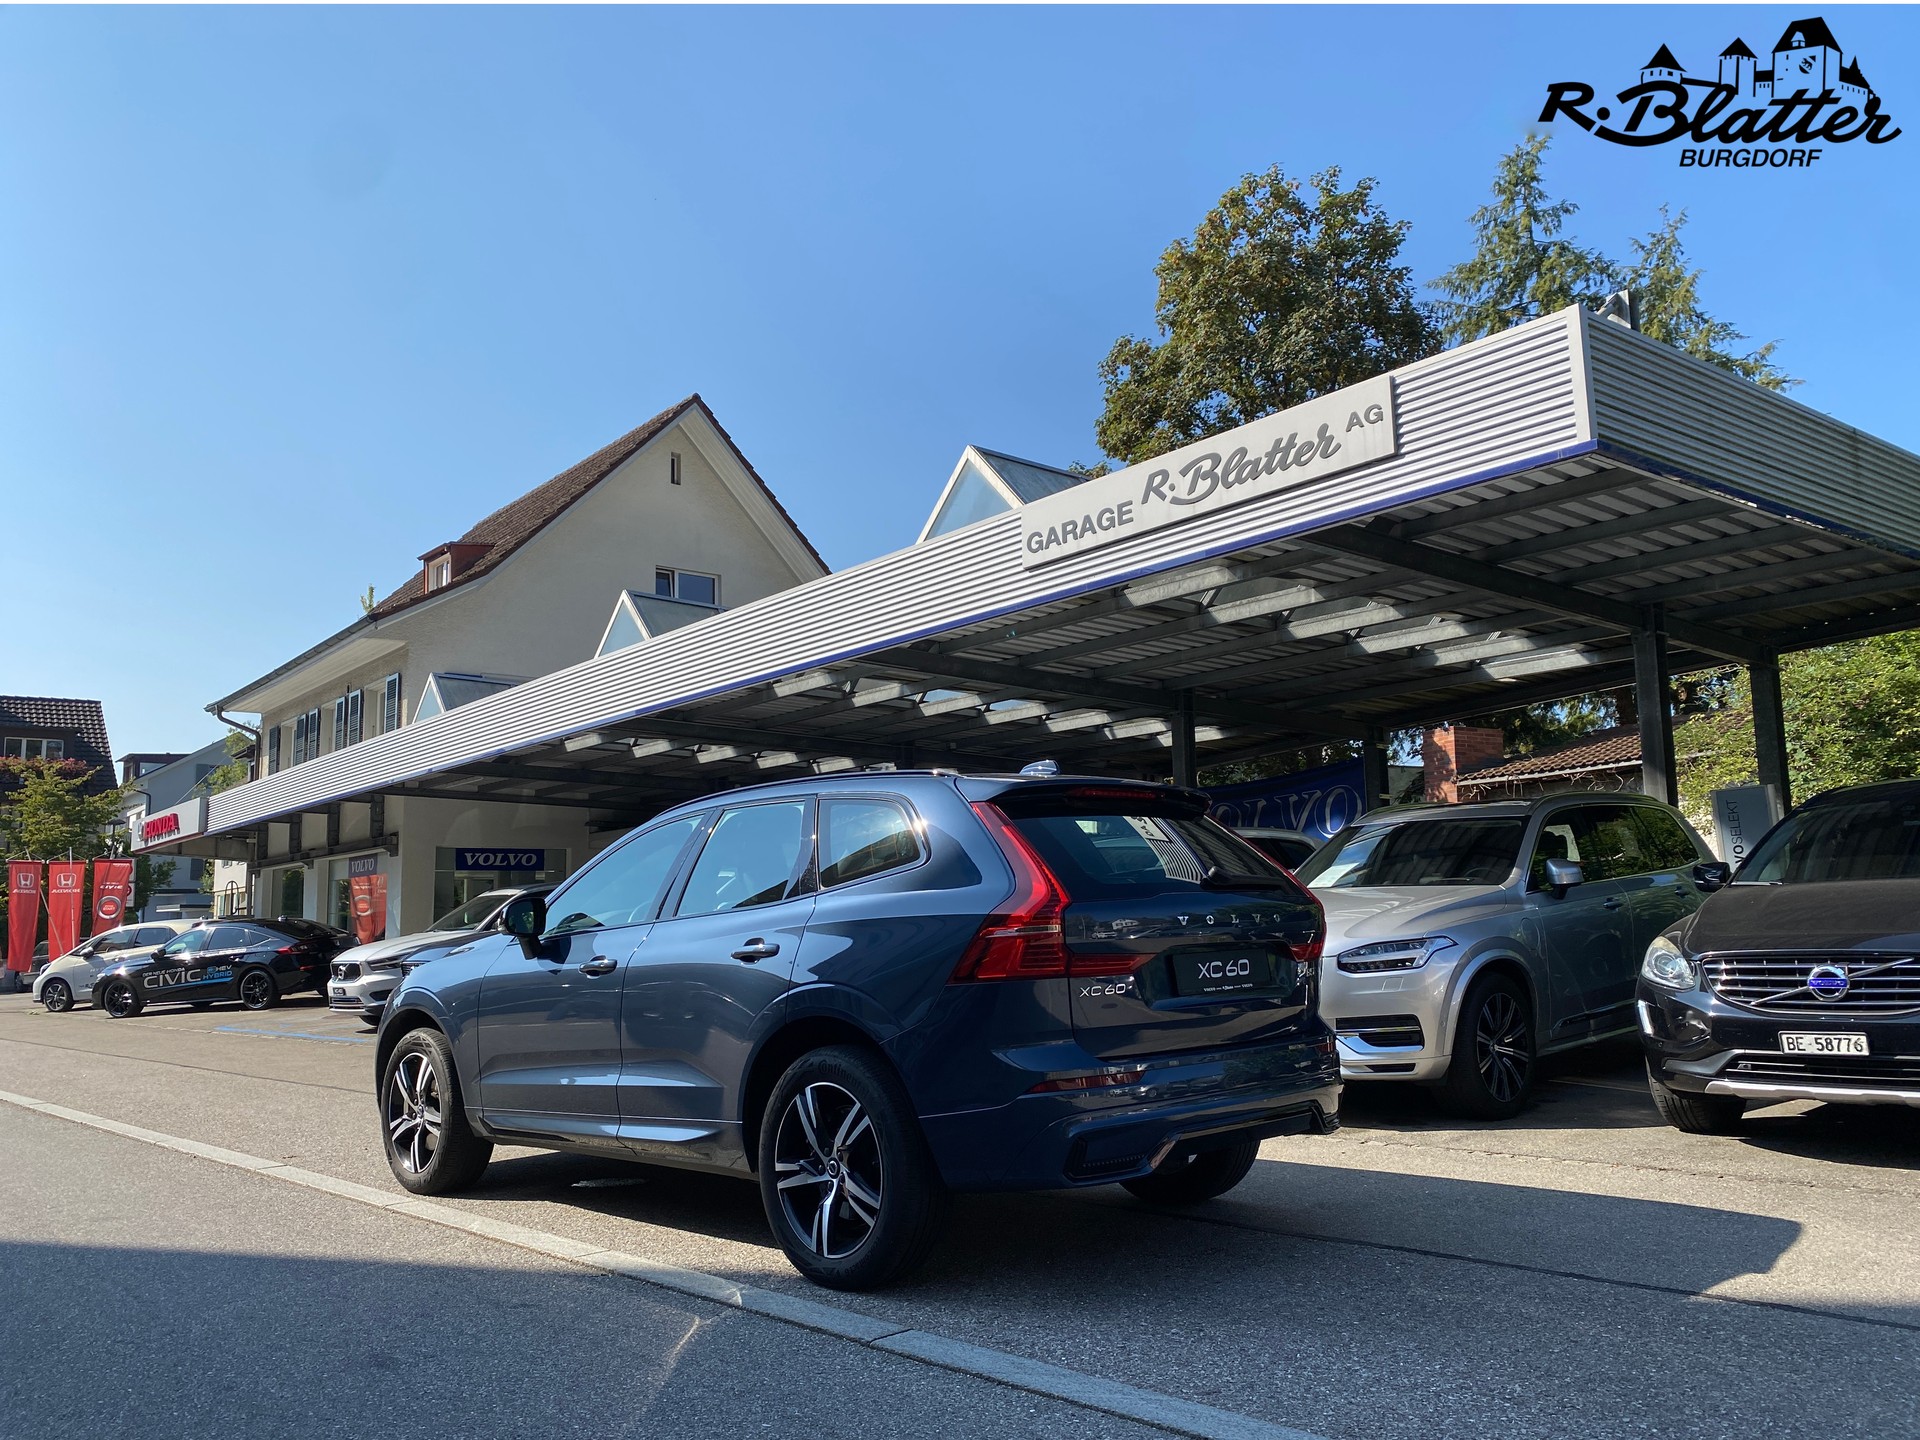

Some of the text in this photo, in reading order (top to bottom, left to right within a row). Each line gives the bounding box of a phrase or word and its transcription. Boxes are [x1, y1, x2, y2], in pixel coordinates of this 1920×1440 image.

[1026, 499, 1135, 555] GARAGE
[1345, 403, 1384, 432] AG
[1208, 785, 1363, 839] OLVO
[144, 813, 180, 840] HONDA
[1726, 800, 1746, 864] VOSELEKT
[351, 858, 375, 873] VOLVO
[464, 853, 537, 866] VOLVO
[1177, 913, 1281, 926] VOLVO
[202, 970, 233, 980] HYBRID
[1198, 958, 1250, 979] XC60
[143, 969, 201, 989] CIVIC
[1079, 982, 1127, 998] XC60
[1786, 1036, 1864, 1053] BE 58776
